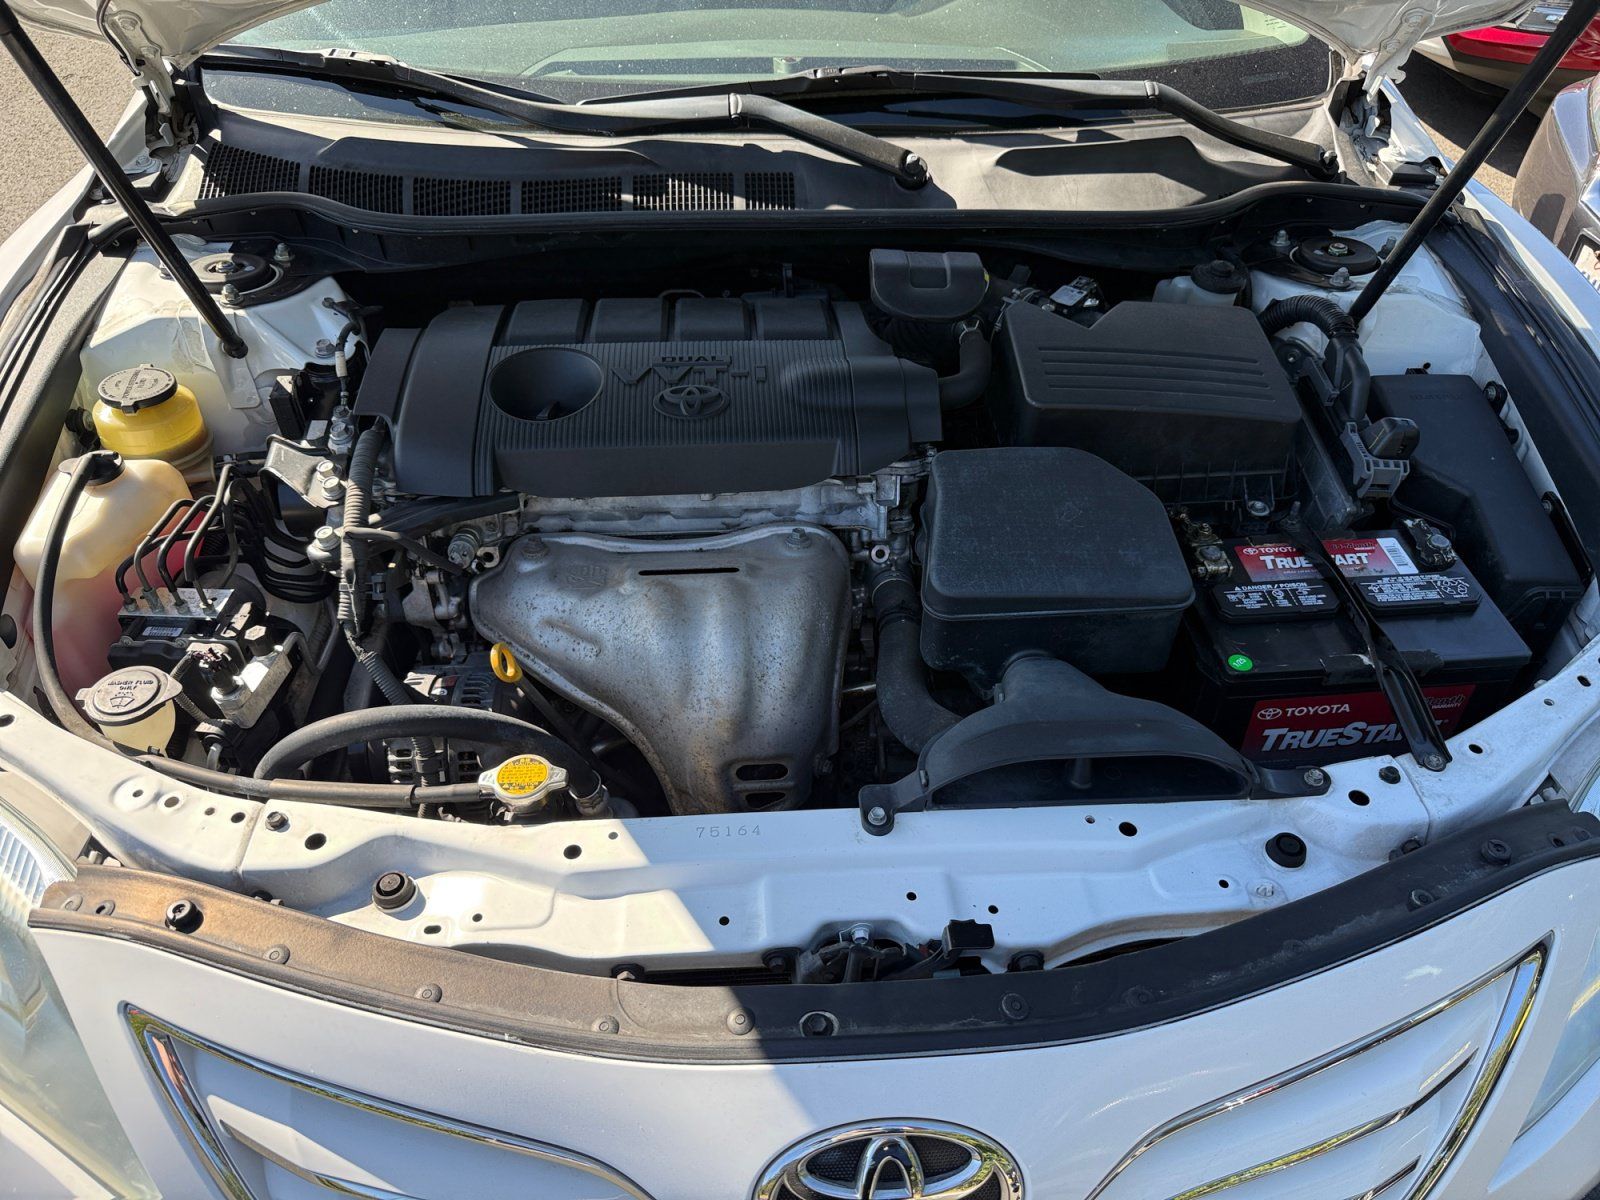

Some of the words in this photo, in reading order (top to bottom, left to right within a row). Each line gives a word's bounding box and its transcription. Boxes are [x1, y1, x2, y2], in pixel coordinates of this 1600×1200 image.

[661, 355, 725, 363] DUAL
[1285, 703, 1351, 717] TOYOTA
[1260, 721, 1442, 752] TRUESTA
[695, 824, 761, 839] 75164
